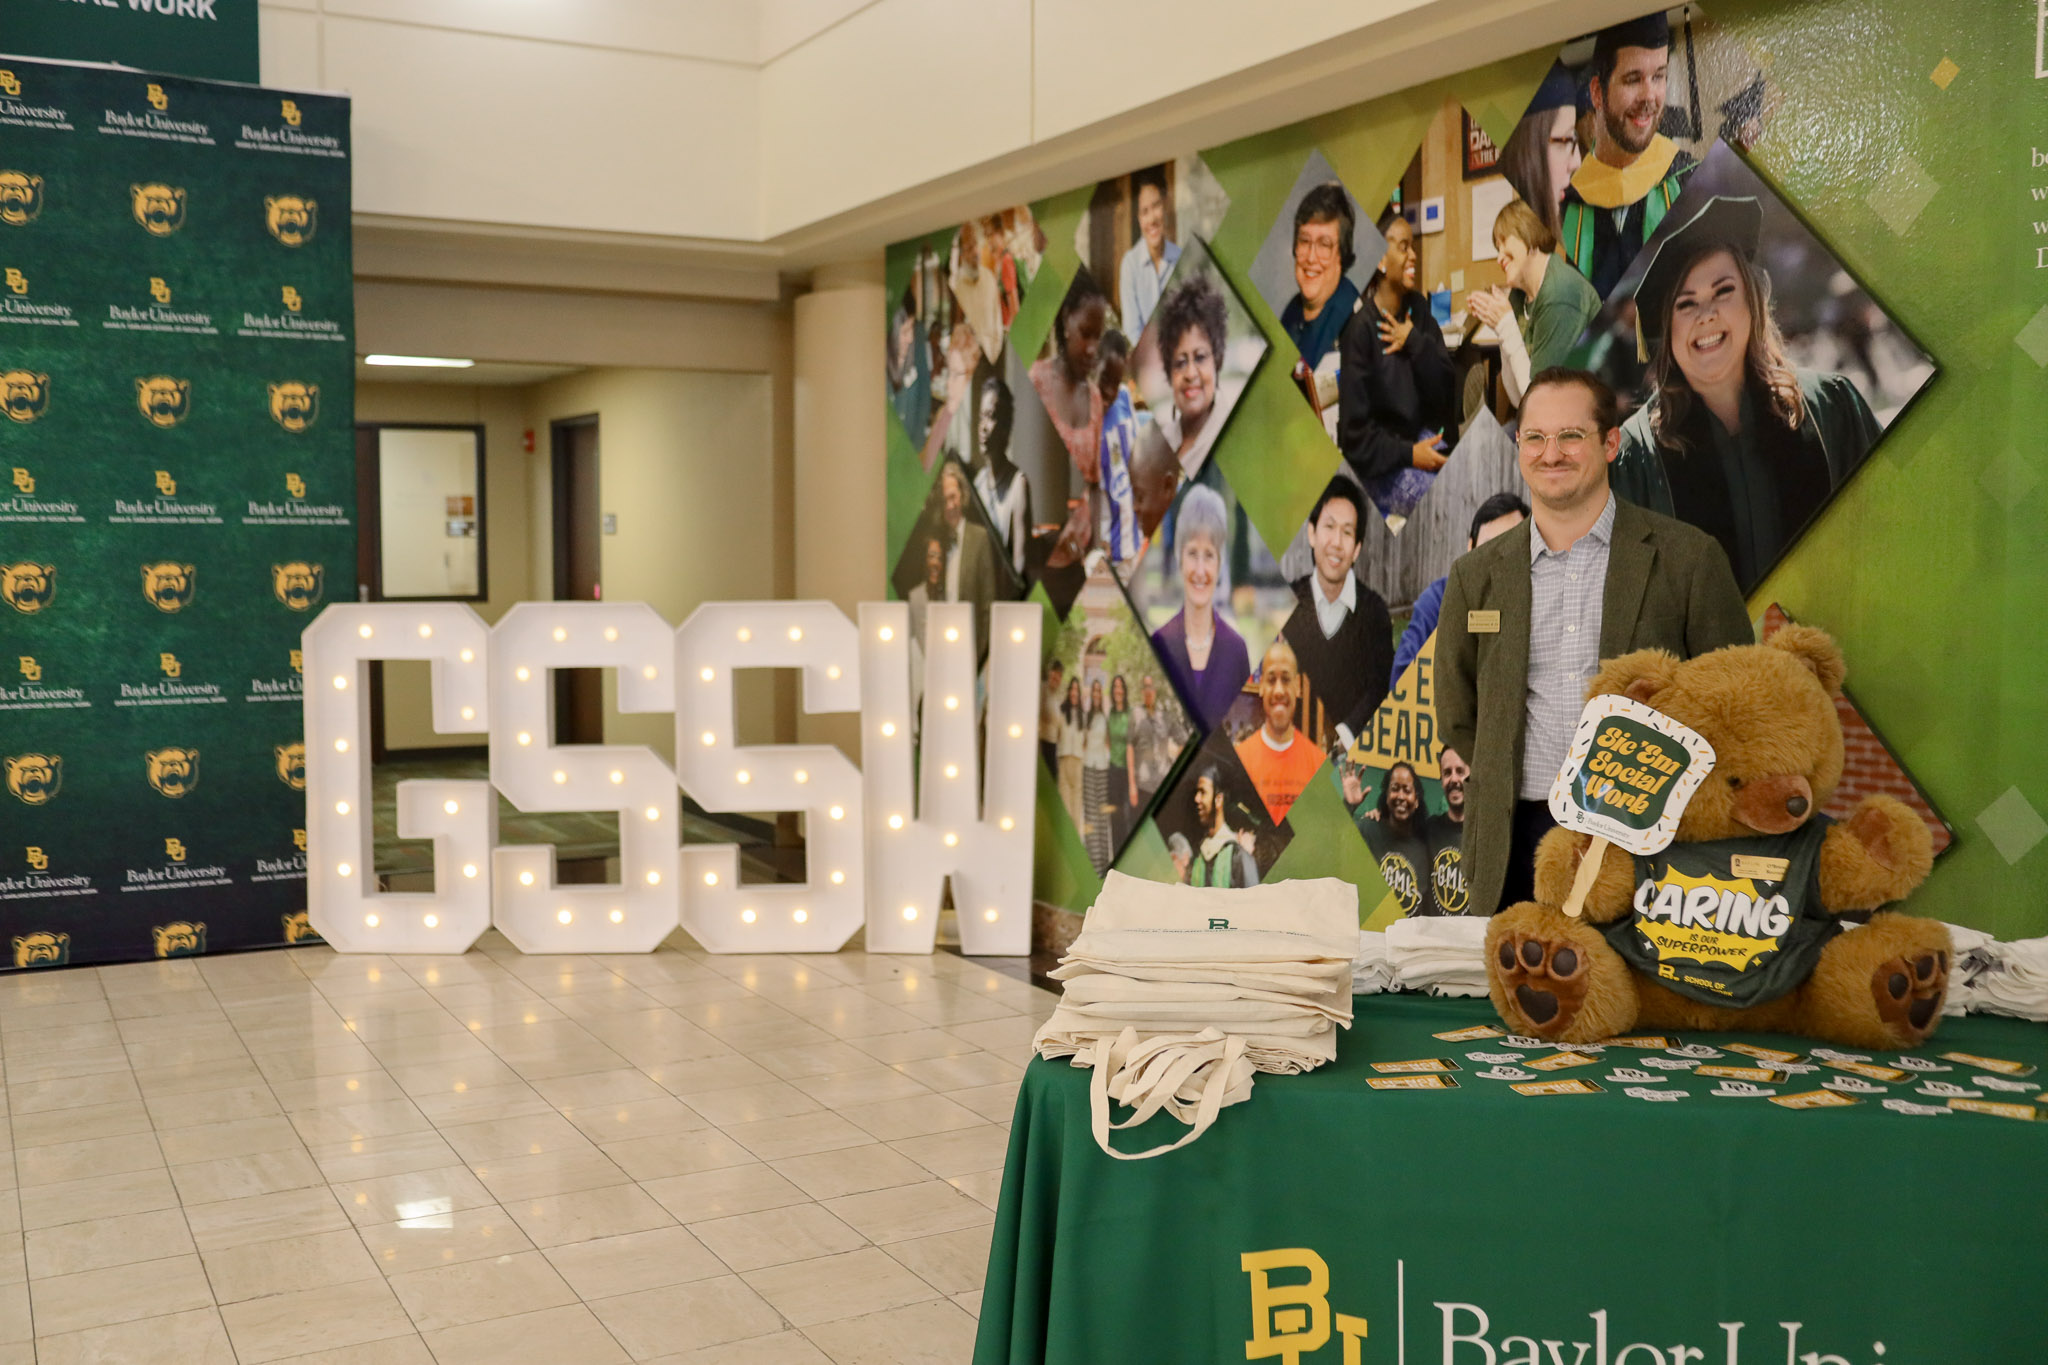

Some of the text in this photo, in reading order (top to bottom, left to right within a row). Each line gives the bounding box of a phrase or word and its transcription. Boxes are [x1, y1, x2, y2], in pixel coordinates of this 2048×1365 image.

[1358, 706, 1442, 764] BEAR
[302, 602, 1042, 955] GSSW
[1585, 774, 1650, 815] Work
[1588, 750, 1671, 795] Social
[1633, 878, 1790, 938] CARING
[1656, 936, 1748, 957] SUPERPOWER
[1689, 933, 1719, 945] IS OUR
